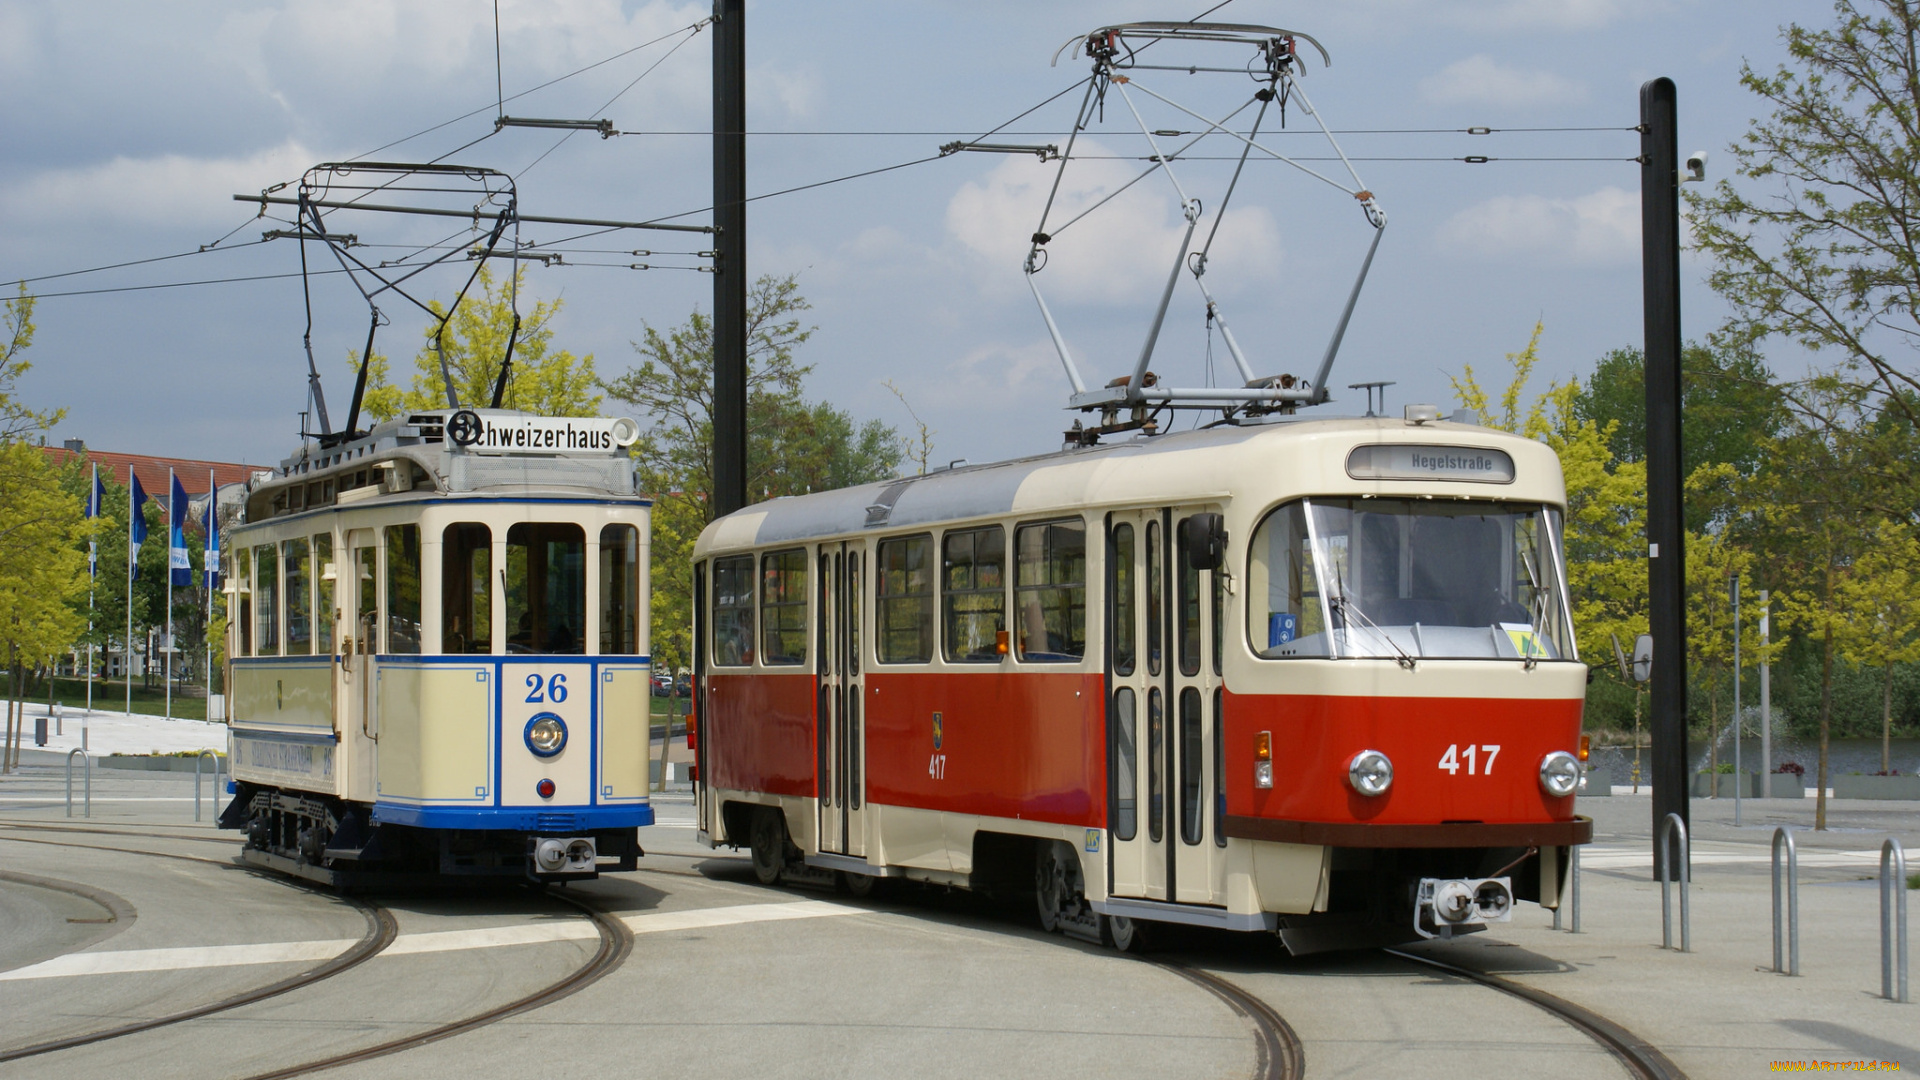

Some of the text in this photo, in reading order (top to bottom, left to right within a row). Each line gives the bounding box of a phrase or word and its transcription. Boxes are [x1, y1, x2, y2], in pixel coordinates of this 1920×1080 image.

[476, 421, 612, 449] chweizerhaus
[1412, 453, 1492, 470] Hegelstraße
[524, 673, 568, 703] 26
[928, 754, 946, 779] 417
[1438, 744, 1501, 775] 417
